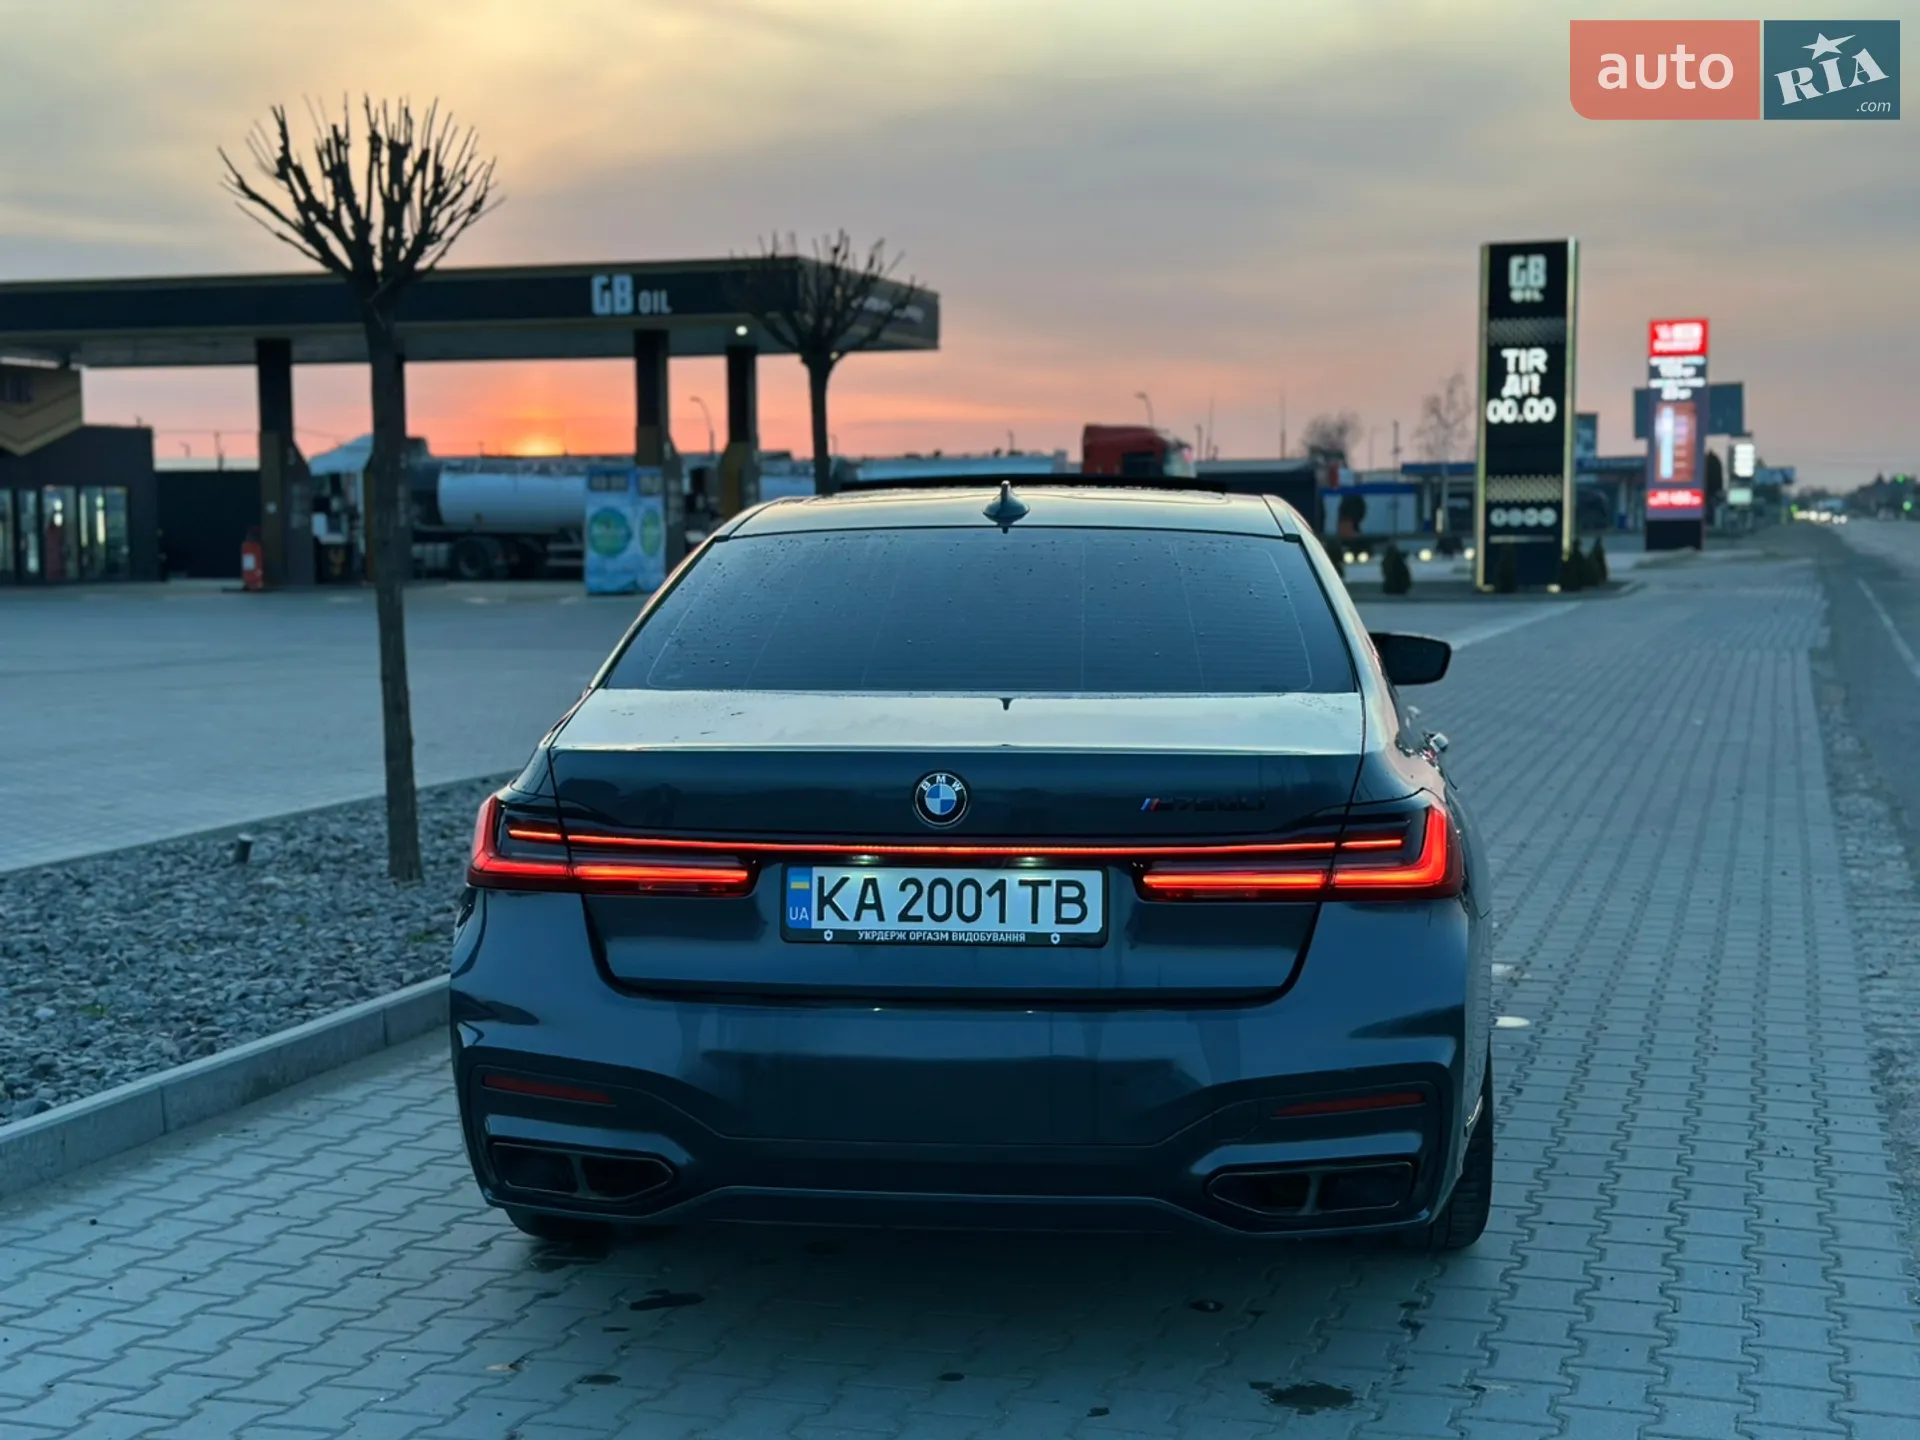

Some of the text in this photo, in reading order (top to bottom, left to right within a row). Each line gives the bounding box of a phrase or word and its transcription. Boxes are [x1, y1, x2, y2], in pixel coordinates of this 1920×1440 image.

[1508, 254, 1547, 288] GB
[590, 274, 672, 315] GB OIL
[1500, 347, 1548, 374] TIR
[1486, 396, 1557, 424] 00.00
[921, 775, 963, 792] BMW
[789, 907, 809, 921] UA
[817, 876, 1088, 925] KA 2001 TB
[858, 930, 1026, 943] УКРДЕРЖ ОРГАЗМ ВИДОБУВАННЯ
